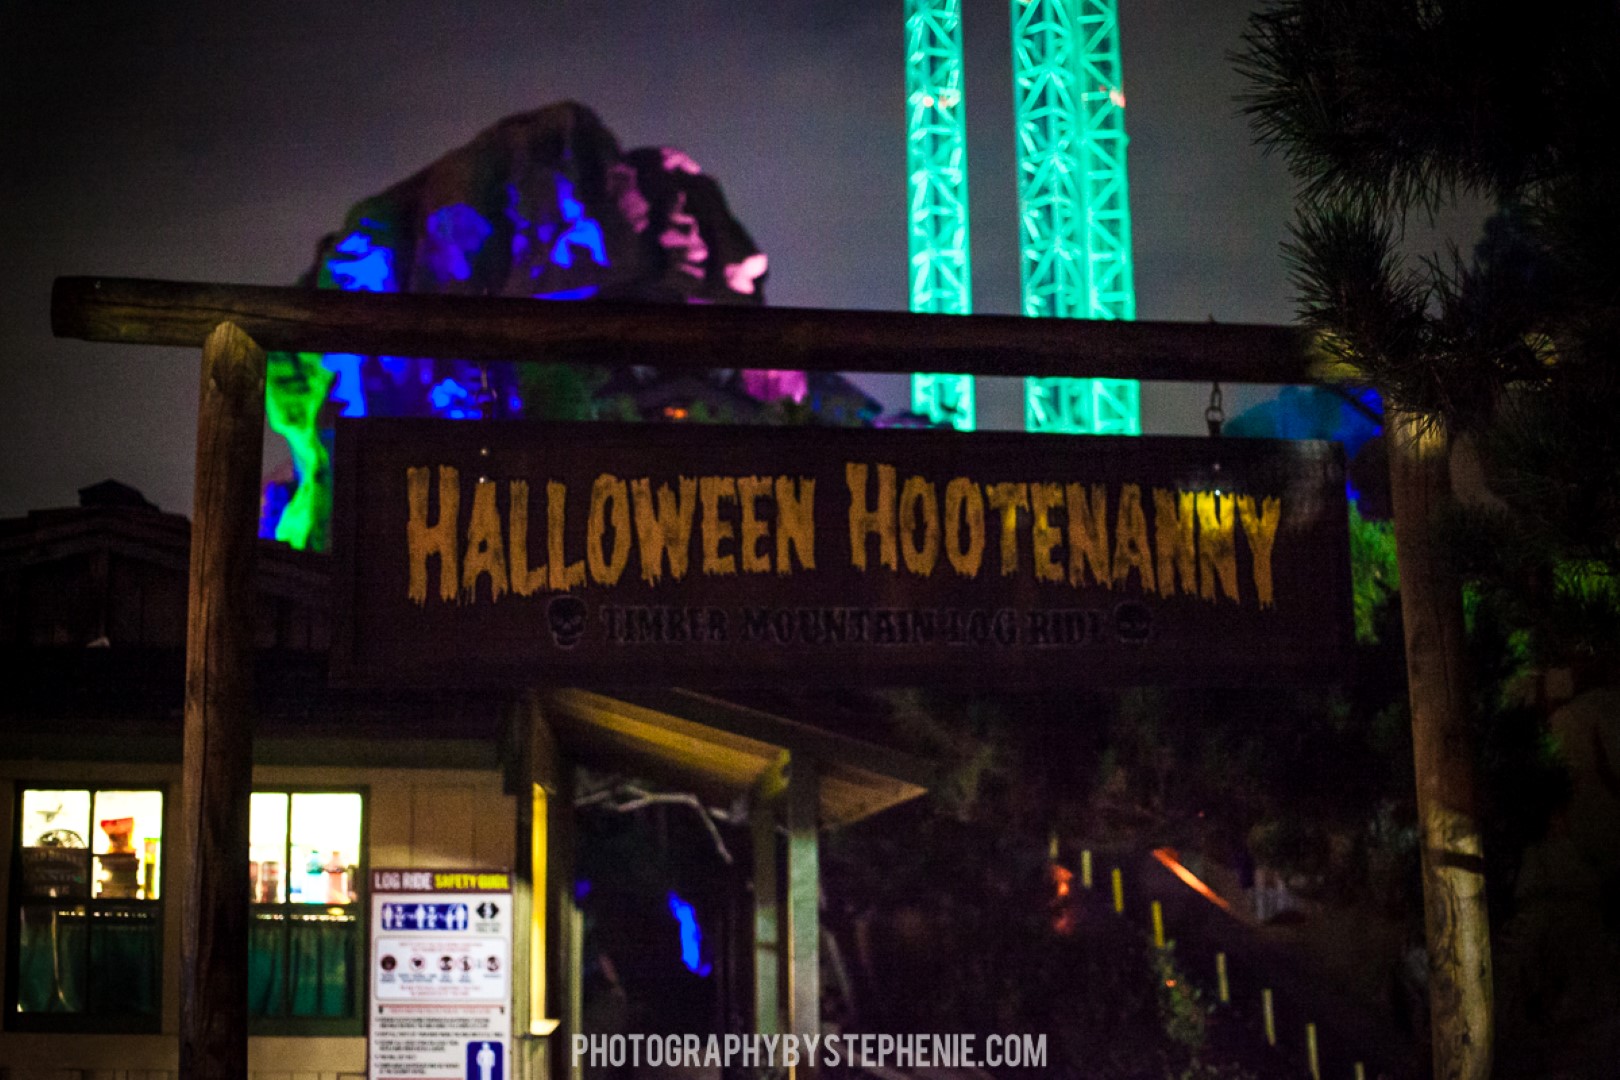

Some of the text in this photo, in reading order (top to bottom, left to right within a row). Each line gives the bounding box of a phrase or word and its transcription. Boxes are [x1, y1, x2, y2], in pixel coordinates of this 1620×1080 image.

[406, 462, 1281, 610] HALLOWEEN HOOTENANNY
[599, 604, 730, 646] TIMBER
[742, 605, 938, 647] MOUNTAIN
[944, 607, 1018, 648] LOG
[374, 872, 400, 890] LOG
